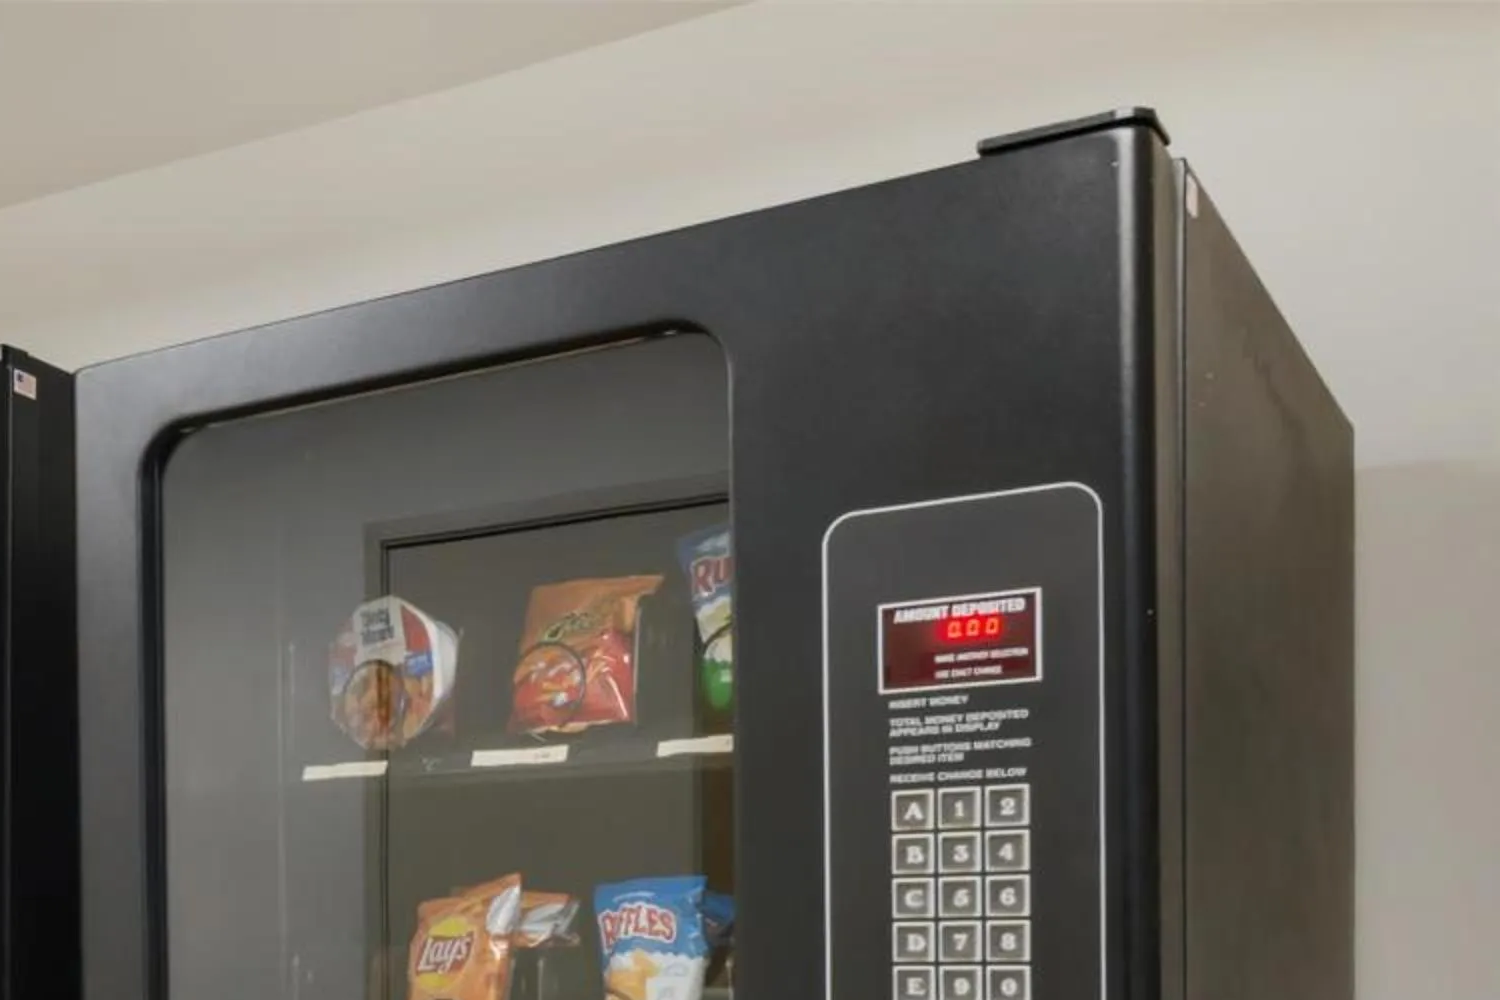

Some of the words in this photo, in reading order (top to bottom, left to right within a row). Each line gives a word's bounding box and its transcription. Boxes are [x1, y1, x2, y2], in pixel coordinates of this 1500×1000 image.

[893, 604, 948, 624] AMOUNT
[951, 597, 1025, 617] DEPOSITED
[888, 698, 927, 709] INSERT
[929, 694, 969, 706] MONEY
[889, 717, 922, 727] TOTAL
[924, 713, 964, 724] MONEY
[965, 708, 1029, 722] DEPOSITED
[889, 725, 940, 738] APPEARS
[955, 721, 1001, 732] DISPLAY
[889, 746, 919, 756] PUSH
[920, 741, 971, 753] BUTTONS
[973, 737, 1032, 751] MATCHING
[889, 754, 936, 766] DESIRED
[937, 752, 965, 763] ITEM
[889, 771, 935, 784] RECEIVE
[937, 769, 983, 781] CHANGE
[985, 767, 1027, 780] BELOW
[903, 801, 924, 821] A
[953, 800, 965, 818] 1
[1000, 797, 1016, 816] 2
[906, 846, 924, 864] B
[952, 844, 969, 863] 3
[999, 843, 1015, 861] 4
[904, 888, 924, 909] C
[1000, 887, 1017, 906] 6
[907, 933, 926, 951] D
[952, 933, 968, 951] 7
[1000, 932, 1017, 951] 8
[906, 977, 926, 996] E
[953, 977, 970, 996] 9
[1001, 977, 1017, 996] 0
